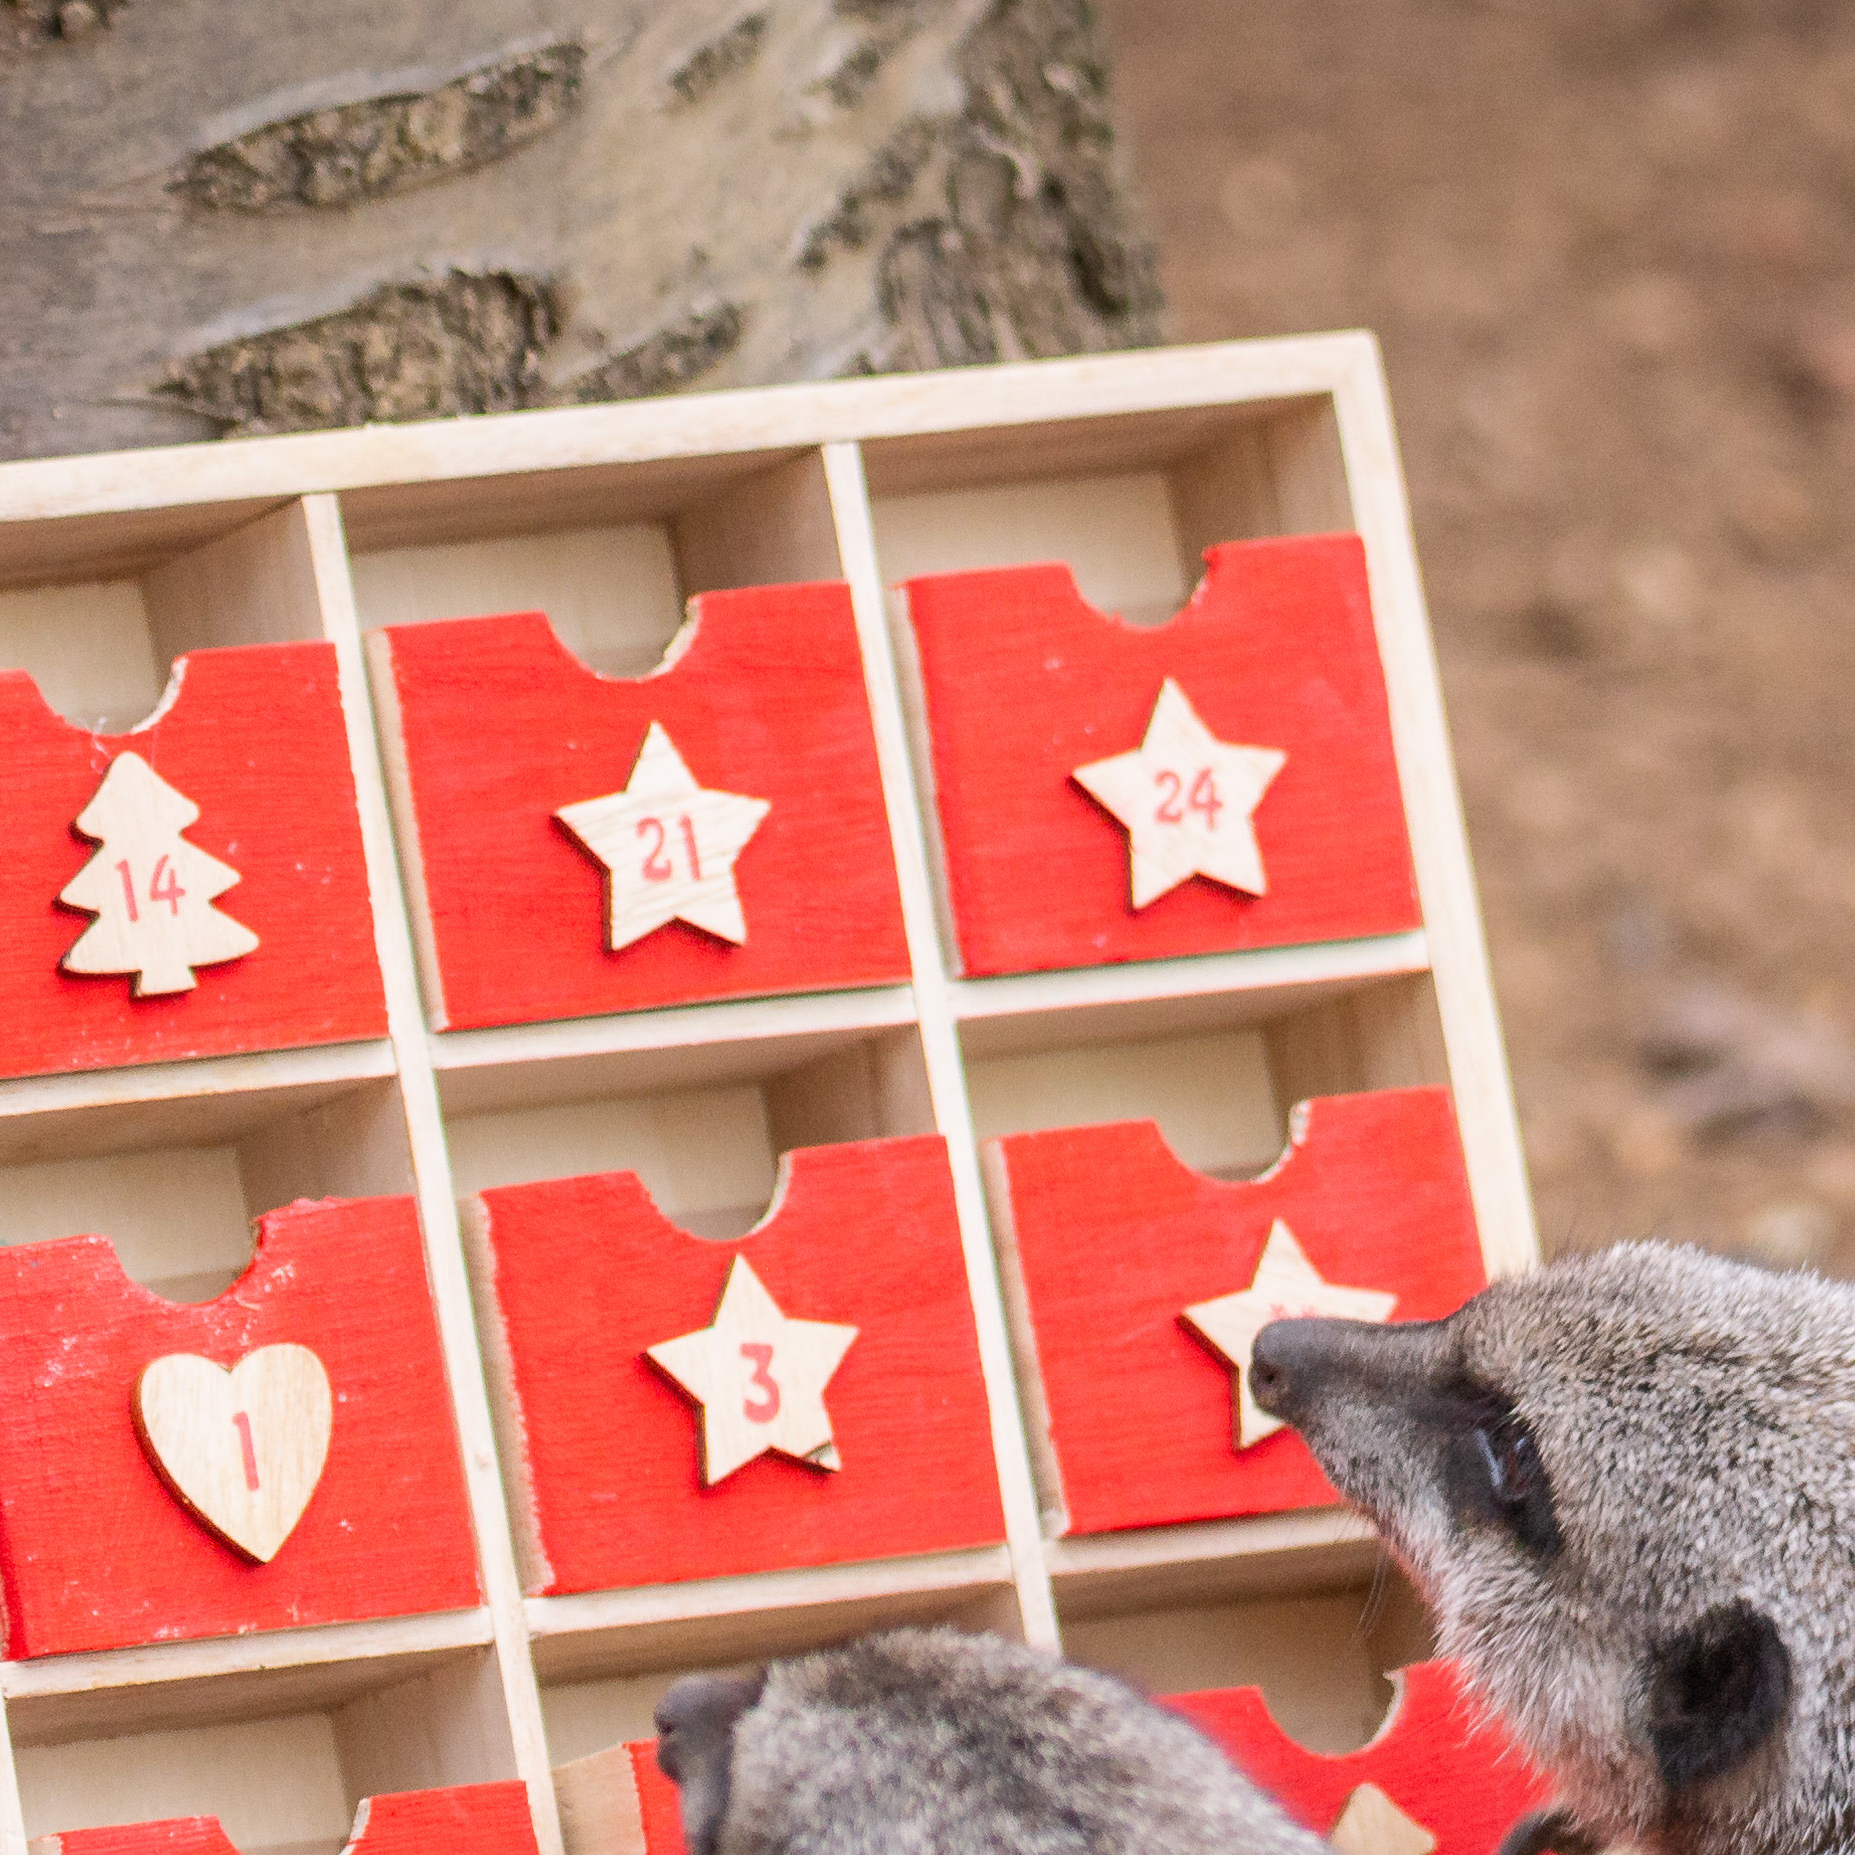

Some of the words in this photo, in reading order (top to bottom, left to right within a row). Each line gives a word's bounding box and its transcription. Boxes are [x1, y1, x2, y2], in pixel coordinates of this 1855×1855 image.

[1157, 769, 1222, 829] 24
[637, 817, 700, 881] 21
[117, 855, 185, 922] 14
[741, 1343, 780, 1423] 3
[234, 1412, 260, 1490] 1
